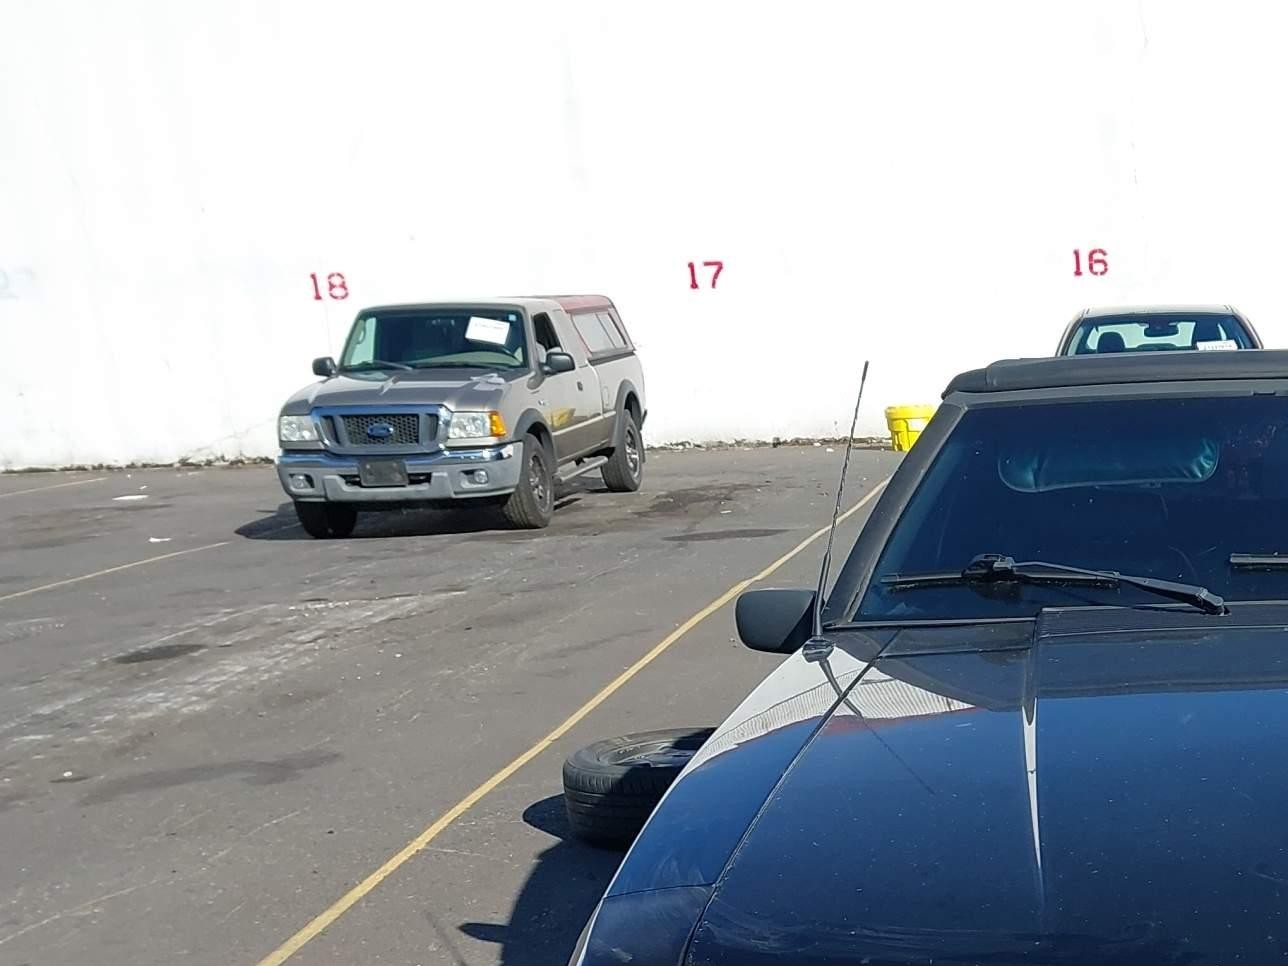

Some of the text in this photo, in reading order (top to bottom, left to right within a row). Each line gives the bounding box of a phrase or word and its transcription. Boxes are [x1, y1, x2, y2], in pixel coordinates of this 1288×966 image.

[687, 260, 725, 290] 17
[1073, 249, 1109, 278] 16
[310, 272, 349, 301] 18
